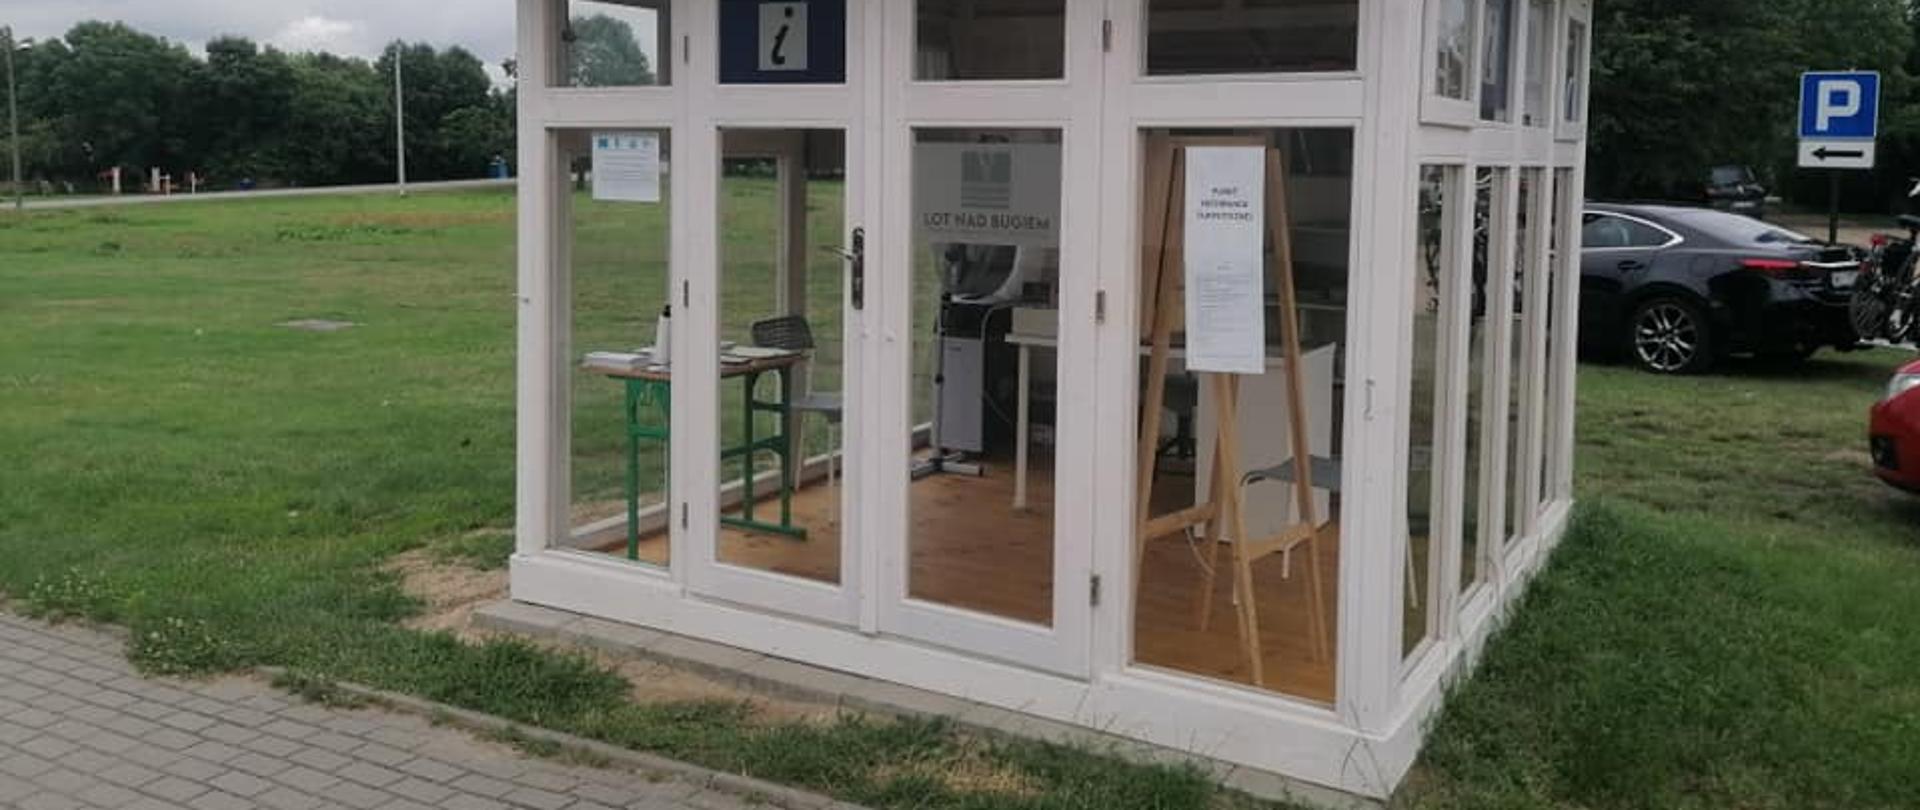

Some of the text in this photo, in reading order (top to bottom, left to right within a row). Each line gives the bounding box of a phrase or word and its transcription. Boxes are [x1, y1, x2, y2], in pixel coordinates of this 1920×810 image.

[771, 6, 794, 65] i
[1816, 80, 1861, 131] P
[923, 212, 951, 227] LOT
[955, 212, 987, 229] NAD
